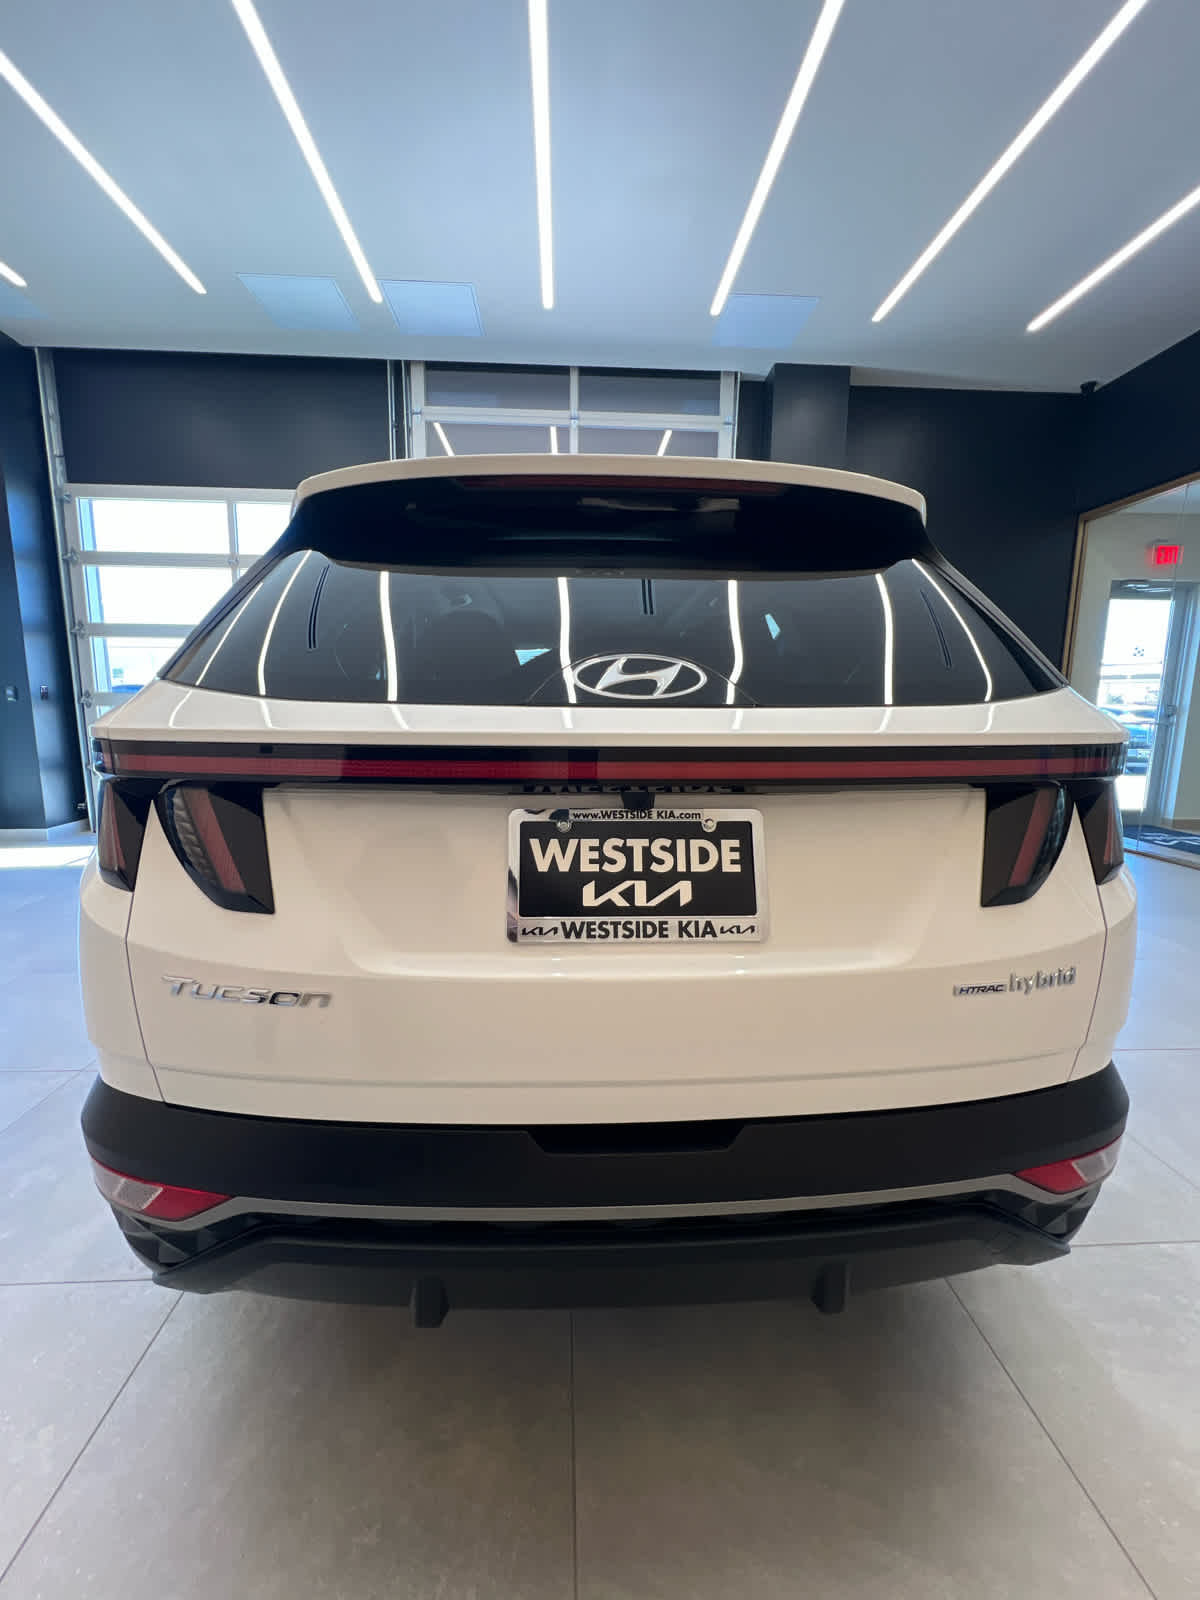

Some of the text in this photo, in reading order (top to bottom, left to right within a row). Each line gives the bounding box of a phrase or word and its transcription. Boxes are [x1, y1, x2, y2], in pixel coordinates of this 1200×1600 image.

[656, 810, 701, 820] KIA.com
[529, 838, 742, 873] WESTSIDE
[560, 920, 669, 939] WESTSIDE
[678, 920, 718, 939] KIA
[958, 966, 1076, 995] HTRAC hybrid
